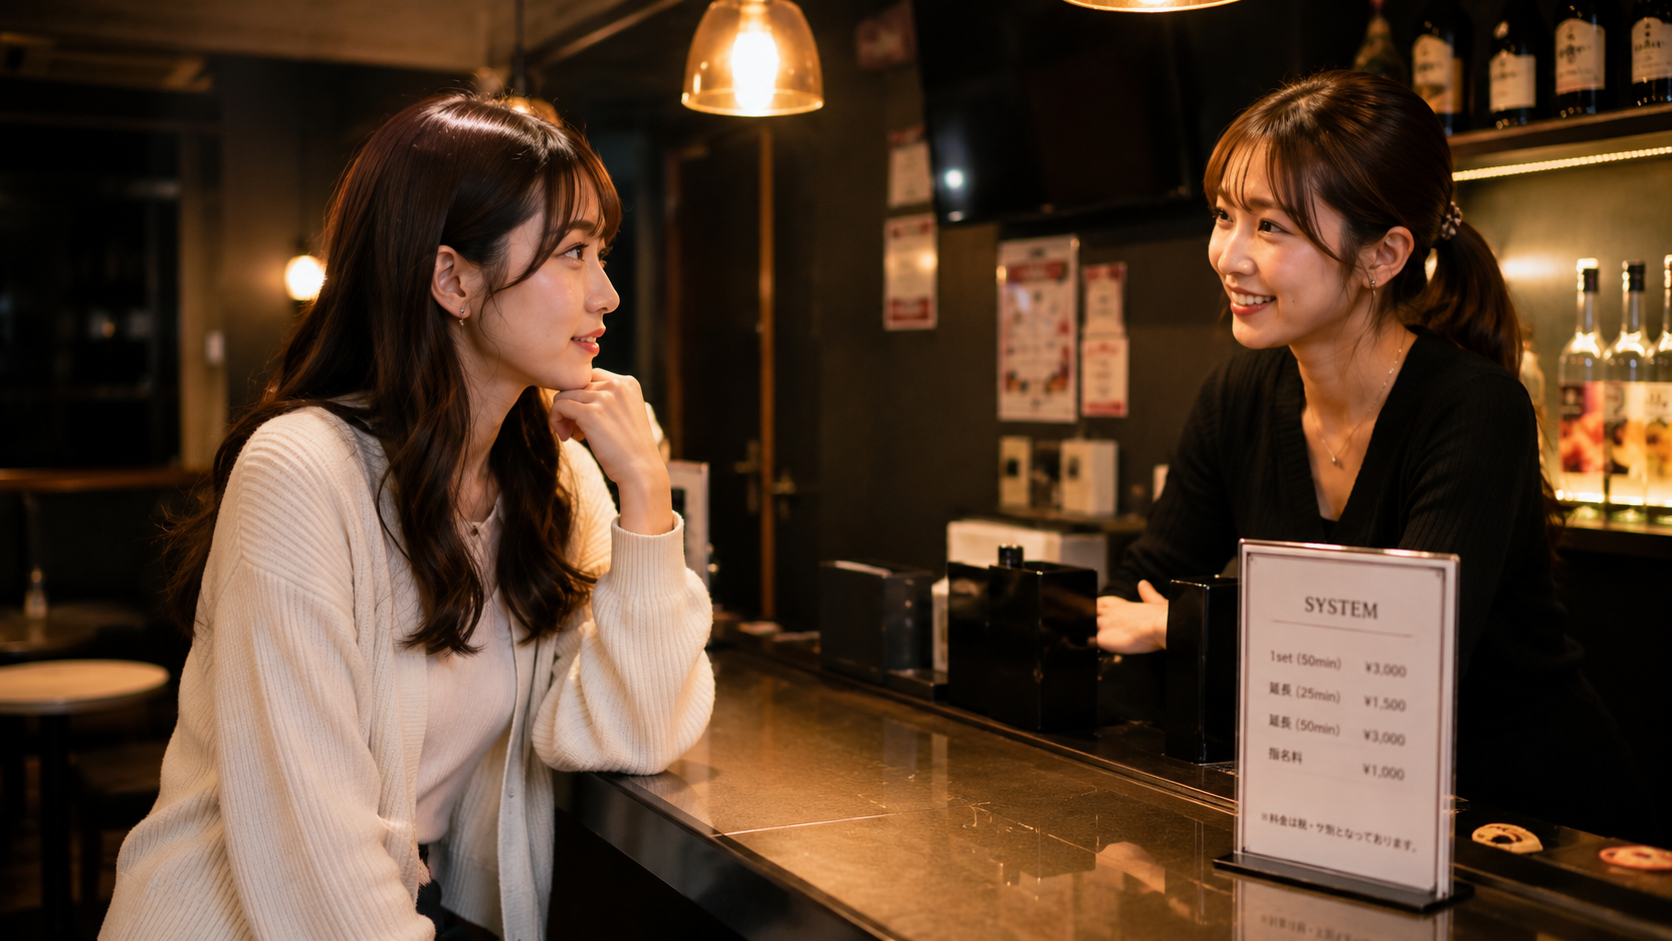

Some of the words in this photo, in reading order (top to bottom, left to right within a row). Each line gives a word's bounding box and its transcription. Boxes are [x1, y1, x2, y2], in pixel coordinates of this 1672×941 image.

[1305, 596, 1378, 619] SYSTEM
[1270, 650, 1293, 664] 1set
[1297, 653, 1342, 671] (50min)
[1365, 662, 1407, 678] ¥3,000
[1269, 681, 1292, 696] 延長
[1296, 685, 1341, 704] (25min)
[1364, 695, 1406, 713] ¥1,500
[1268, 714, 1292, 729] 延長
[1296, 718, 1341, 737] (50min)
[1363, 729, 1406, 747] ¥3,000
[1268, 747, 1302, 764] 指名料
[1362, 763, 1405, 781] ¥1,000
